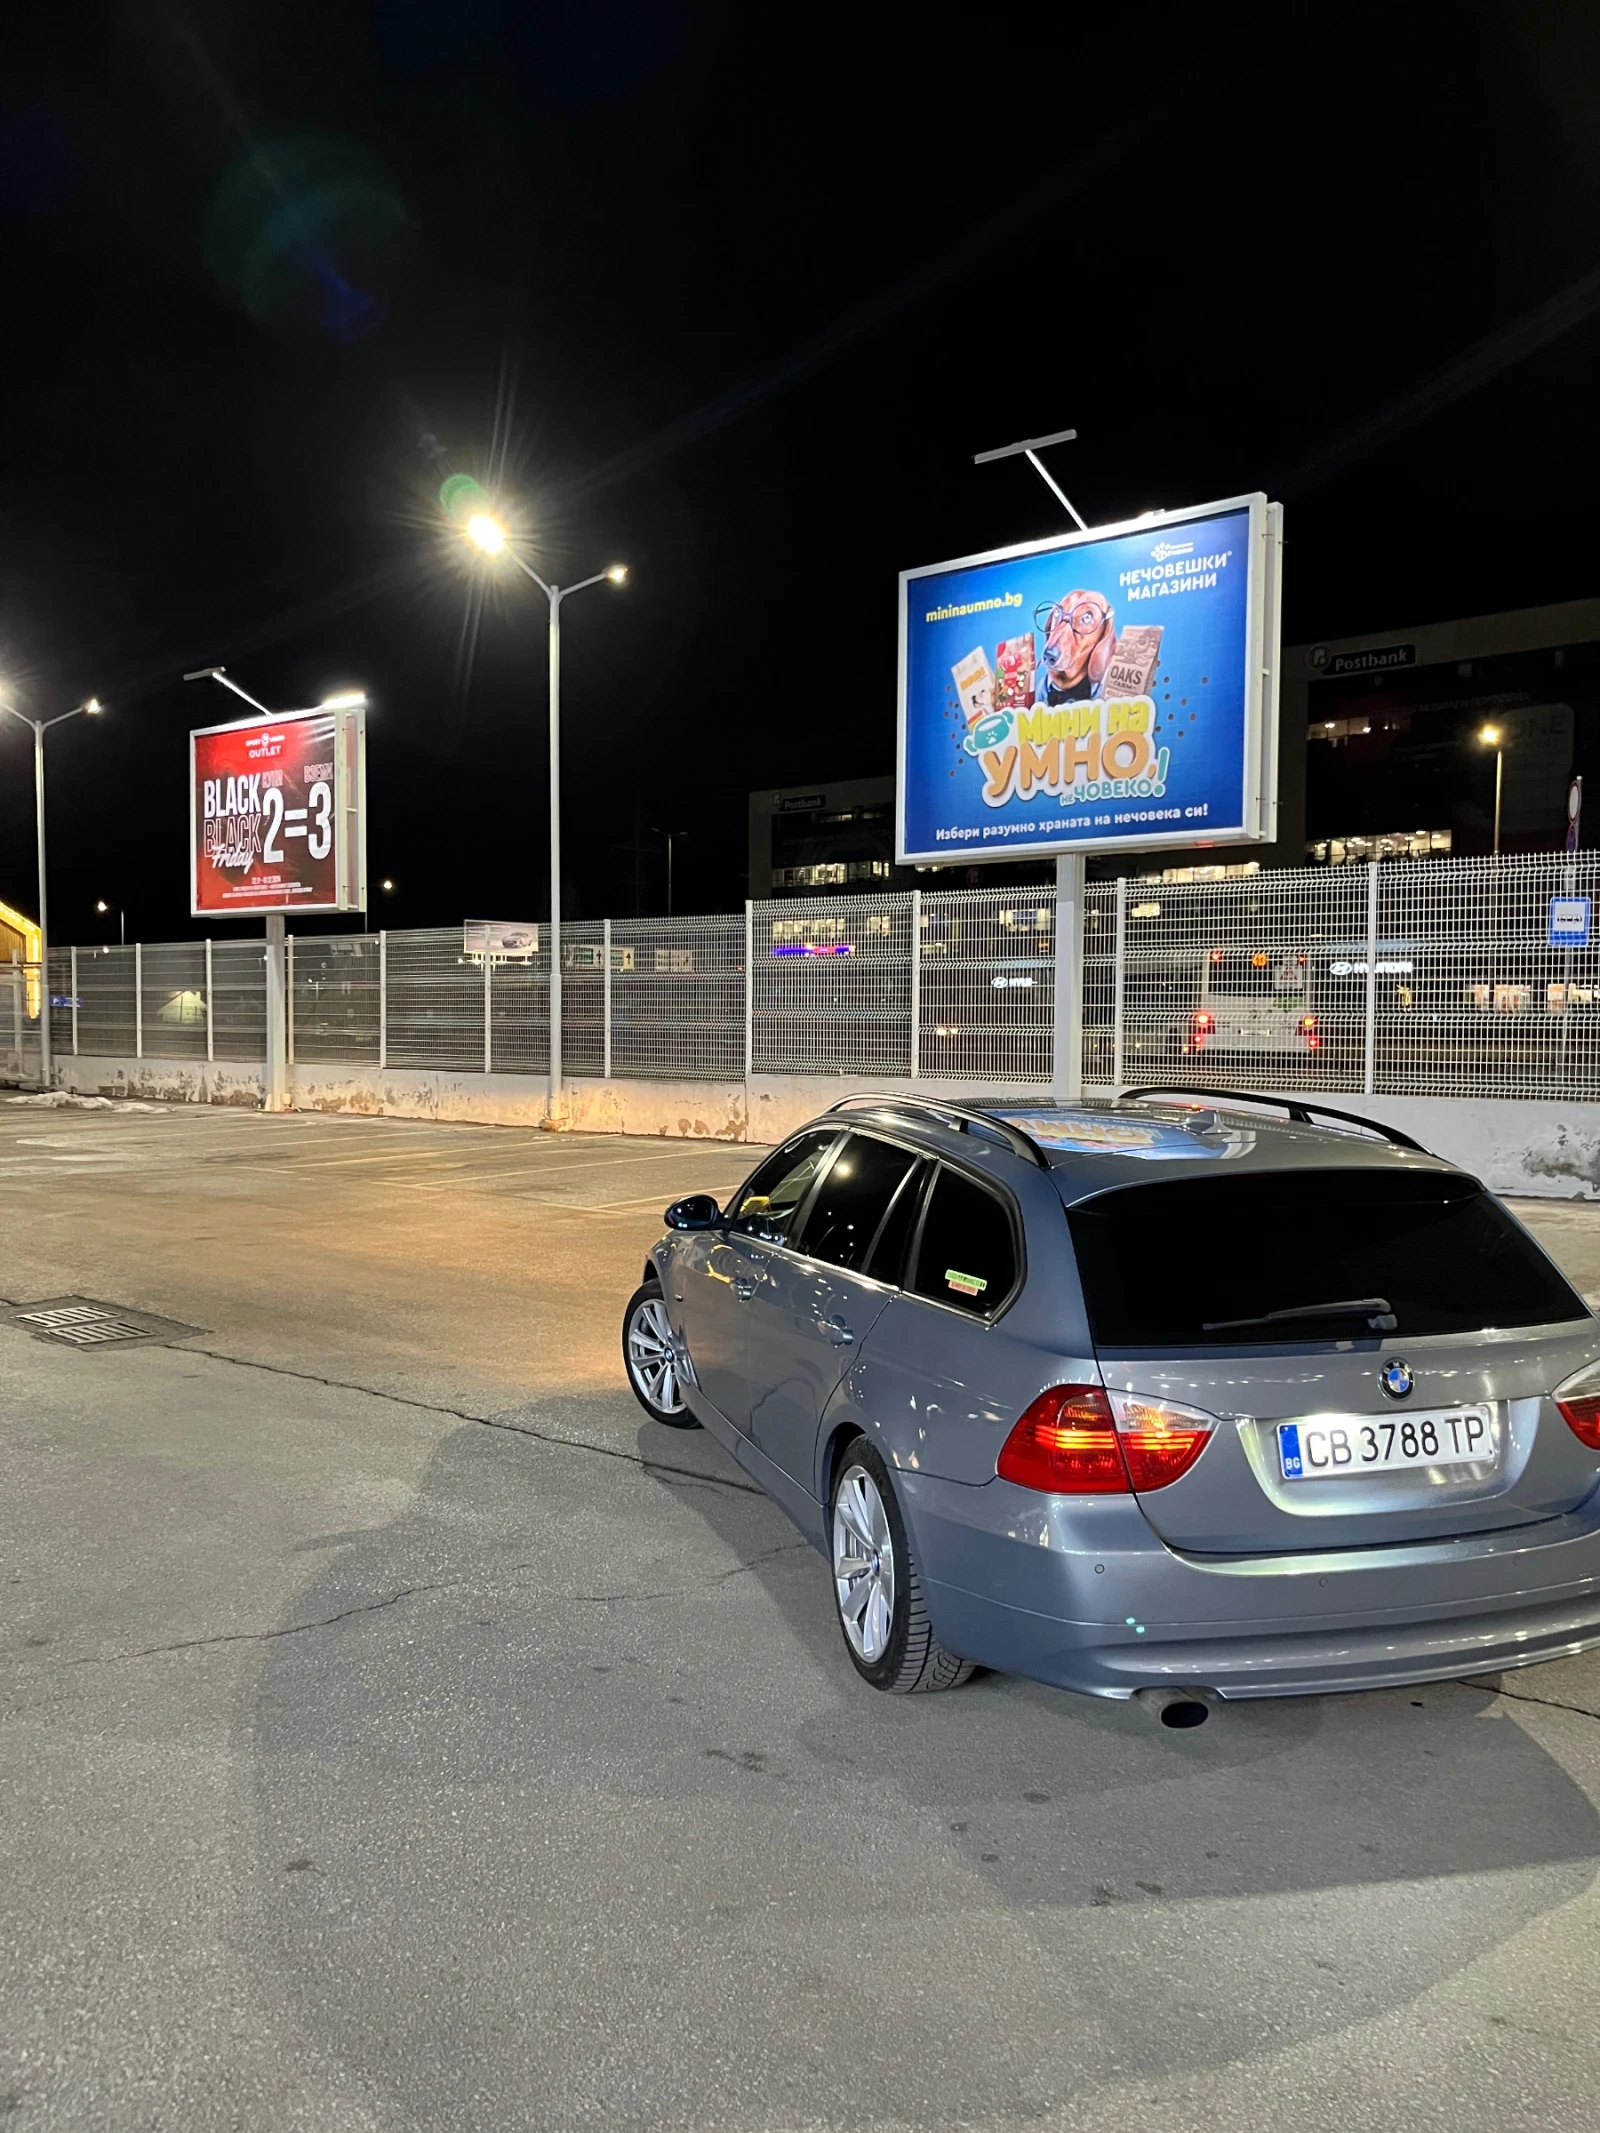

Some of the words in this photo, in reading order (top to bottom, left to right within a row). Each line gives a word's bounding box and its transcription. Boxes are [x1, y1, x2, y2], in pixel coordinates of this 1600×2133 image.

[1127, 573, 1217, 601] МАГАЗИНИ
[926, 591, 1023, 622] mininaumno.bg
[1110, 665, 1143, 685] OAKS
[1335, 648, 1408, 671] Postbank
[249, 745, 282, 759] OUTLET
[204, 773, 262, 818] BLACK
[204, 813, 262, 858] BLACK
[936, 827, 980, 841] Избери
[983, 821, 1035, 838] разумно
[1039, 816, 1091, 831] храната
[1094, 814, 1111, 825] на
[1114, 808, 1181, 824] нечовека
[1184, 803, 1209, 817] си!
[211, 842, 254, 875] Friday
[1306, 1429, 1352, 1468] CB
[1360, 1420, 1439, 1462] 3788
[1445, 1416, 1484, 1453] TP
[1285, 1457, 1301, 1470] BG
